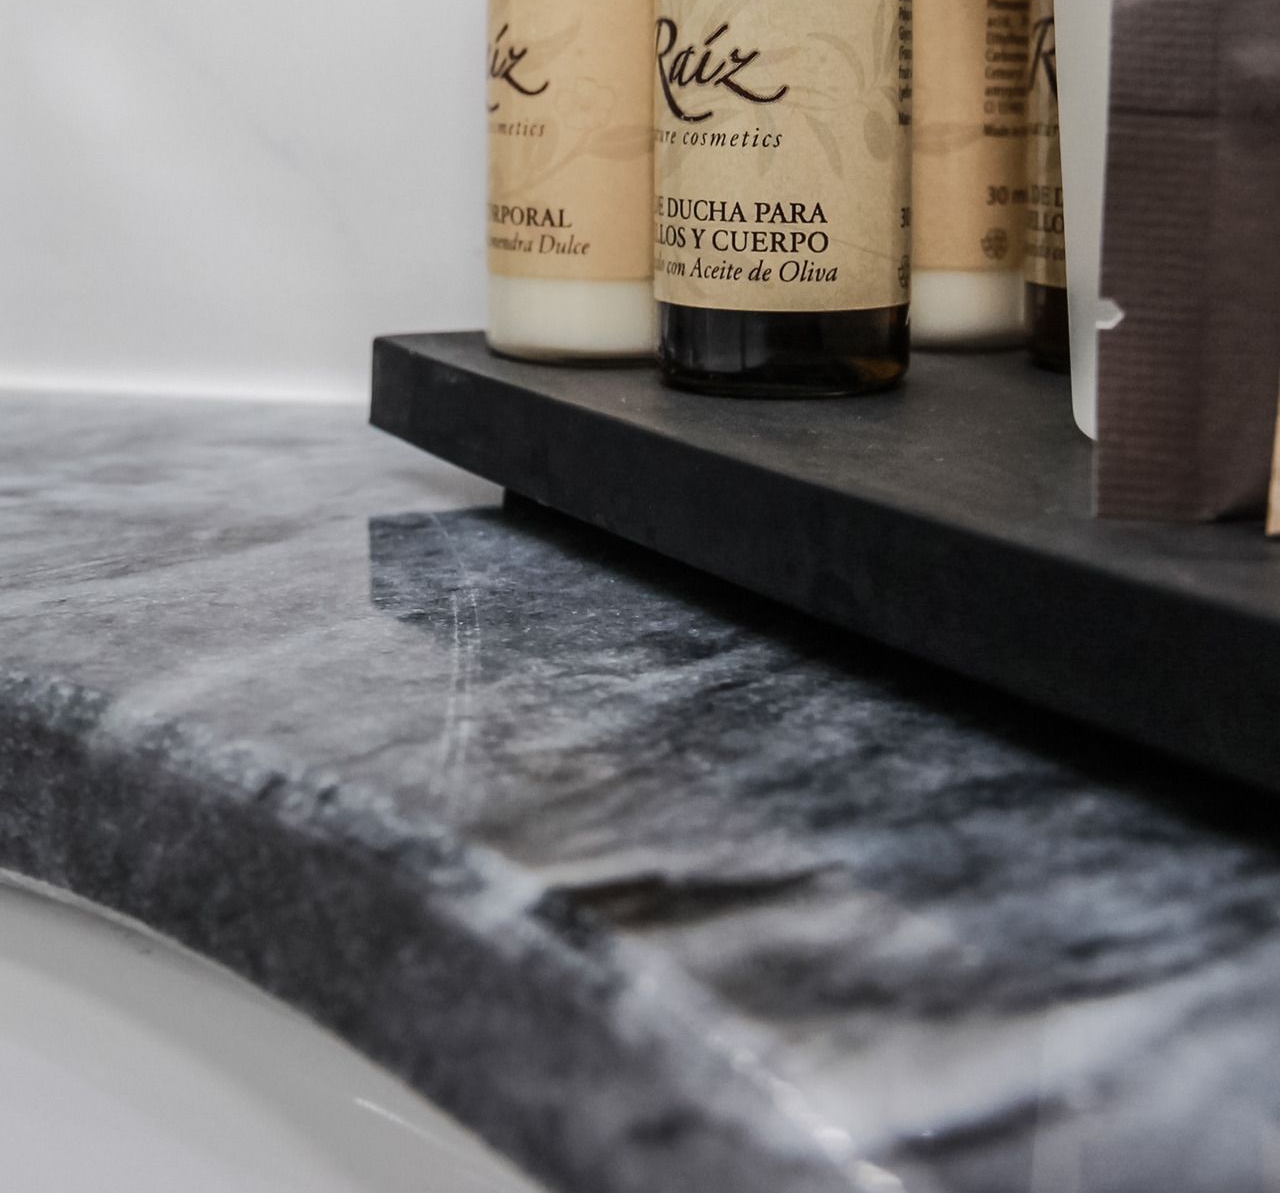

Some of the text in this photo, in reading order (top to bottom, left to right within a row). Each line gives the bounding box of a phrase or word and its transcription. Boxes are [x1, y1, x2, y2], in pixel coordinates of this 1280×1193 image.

[656, 17, 789, 122] Raíz
[683, 127, 782, 148] cosmetics
[667, 197, 747, 223] DUCHA
[754, 202, 828, 223] PARA
[539, 234, 590, 256] Dulce
[691, 228, 706, 249] Y
[712, 229, 829, 253] CUERPO
[666, 260, 686, 277] con
[690, 257, 743, 281] Aceite
[748, 259, 772, 282] de
[779, 259, 838, 283] Oliva
